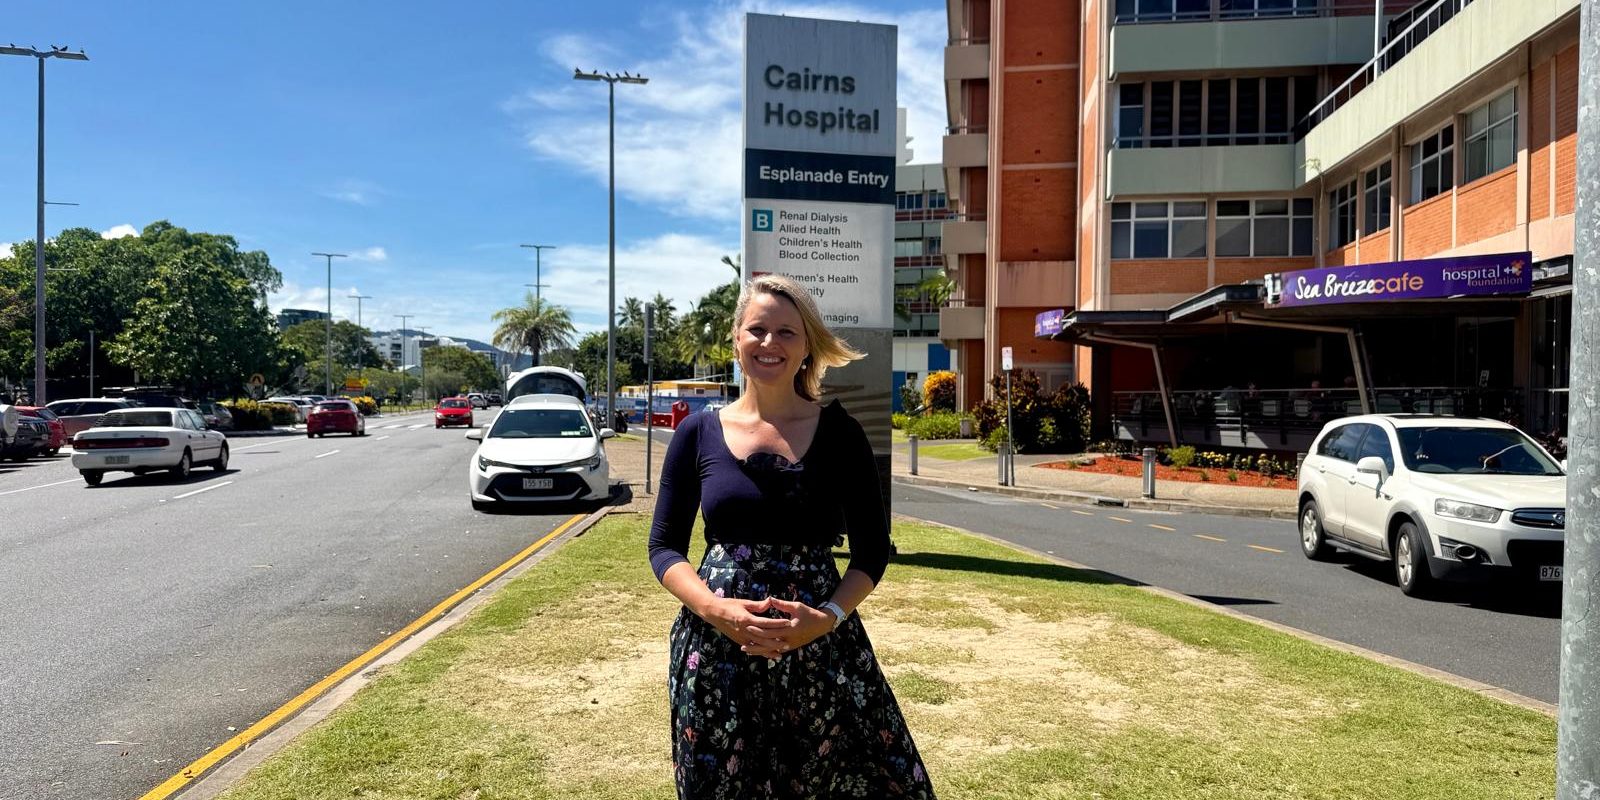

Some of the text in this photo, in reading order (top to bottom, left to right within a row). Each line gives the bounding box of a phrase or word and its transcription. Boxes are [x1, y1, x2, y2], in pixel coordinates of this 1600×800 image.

[764, 65, 855, 95] Cairns
[765, 102, 879, 134] Hospital
[759, 166, 889, 188] Esplanade Entry
[756, 213, 769, 229] B
[779, 211, 848, 224] Renal Dialysis
[779, 224, 841, 235] Allied Health
[779, 237, 862, 249] Children's Health
[779, 250, 860, 262] Blood Collection
[828, 275, 858, 284] Health
[1442, 264, 1500, 284] hospital
[1295, 276, 1321, 299] Sea
[1542, 566, 1560, 577] 876
